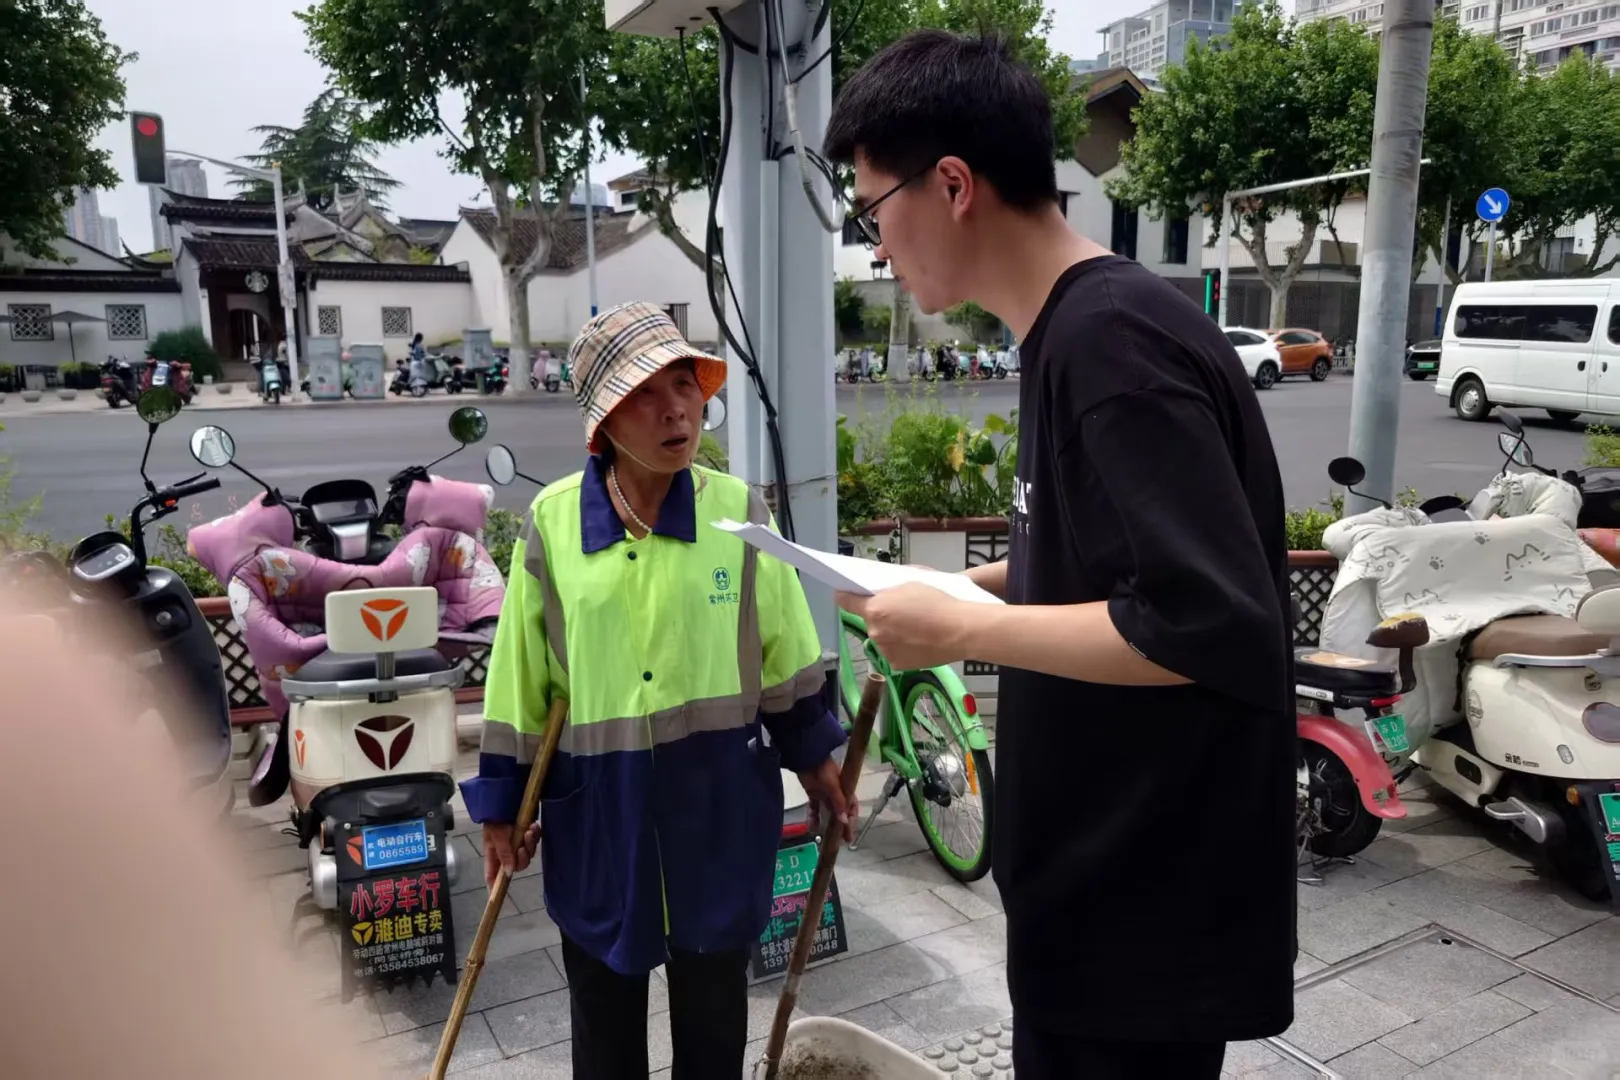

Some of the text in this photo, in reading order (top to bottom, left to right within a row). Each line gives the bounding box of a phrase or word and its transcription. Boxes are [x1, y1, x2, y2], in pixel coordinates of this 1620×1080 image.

[377, 832, 424, 848] 电动自行车
[379, 844, 424, 859] 0865589
[789, 855, 800, 868] D
[350, 872, 441, 921] 小罗车行
[374, 909, 443, 944] 雅迪专卖
